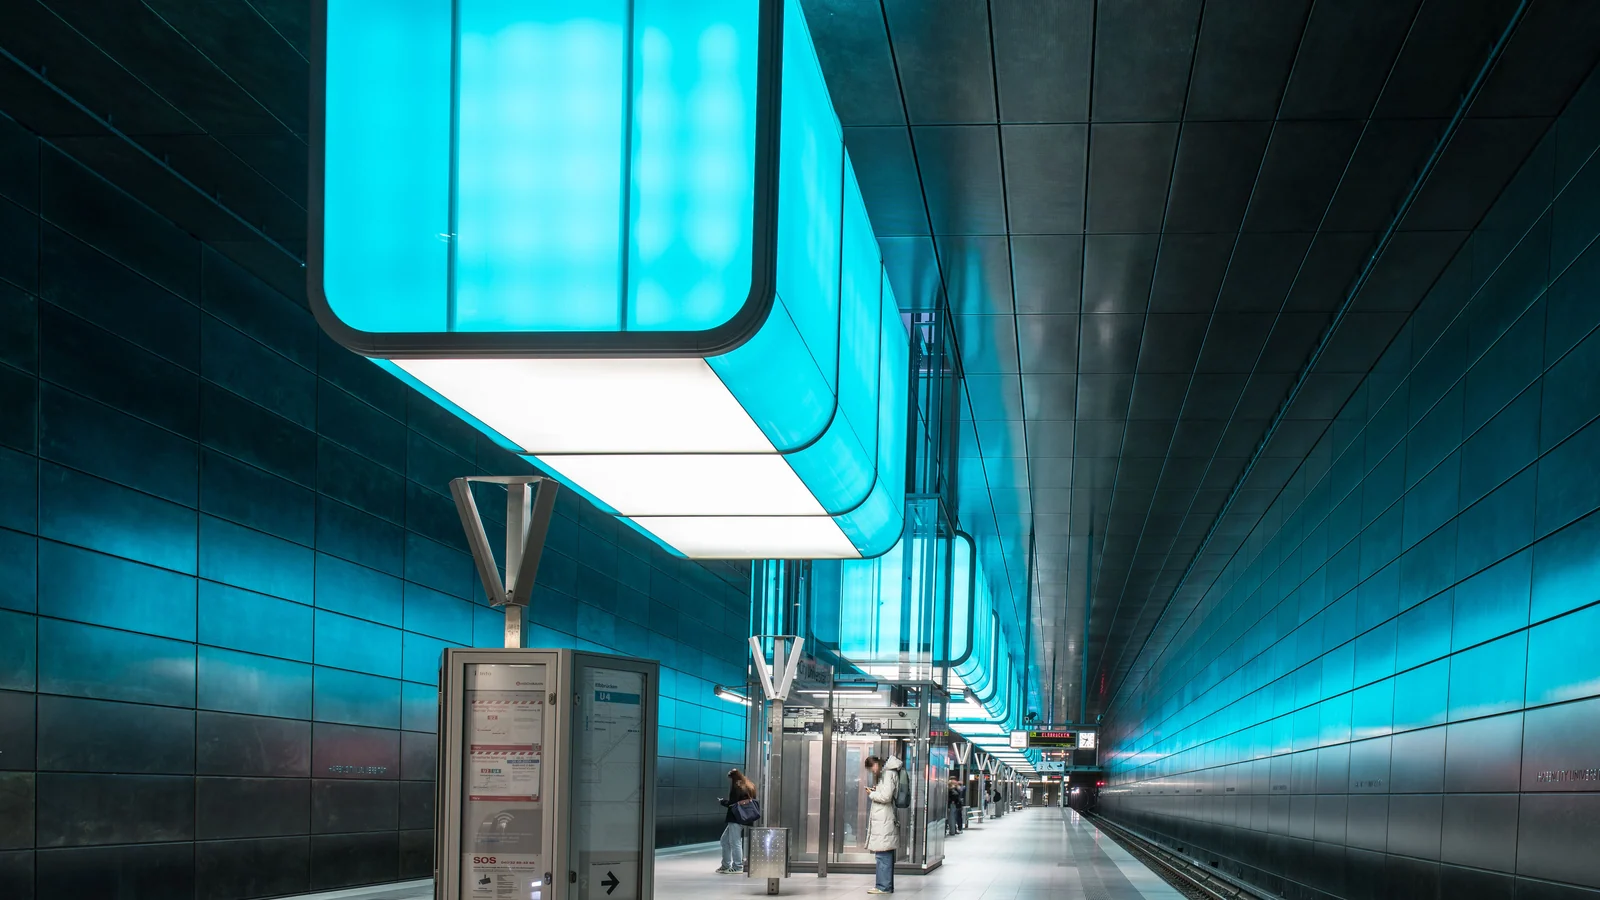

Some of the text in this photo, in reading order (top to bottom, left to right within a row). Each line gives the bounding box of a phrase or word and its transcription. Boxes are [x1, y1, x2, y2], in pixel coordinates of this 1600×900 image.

[599, 692, 611, 701] U4
[473, 856, 497, 865] SOS
[581, 879, 587, 889] 2
